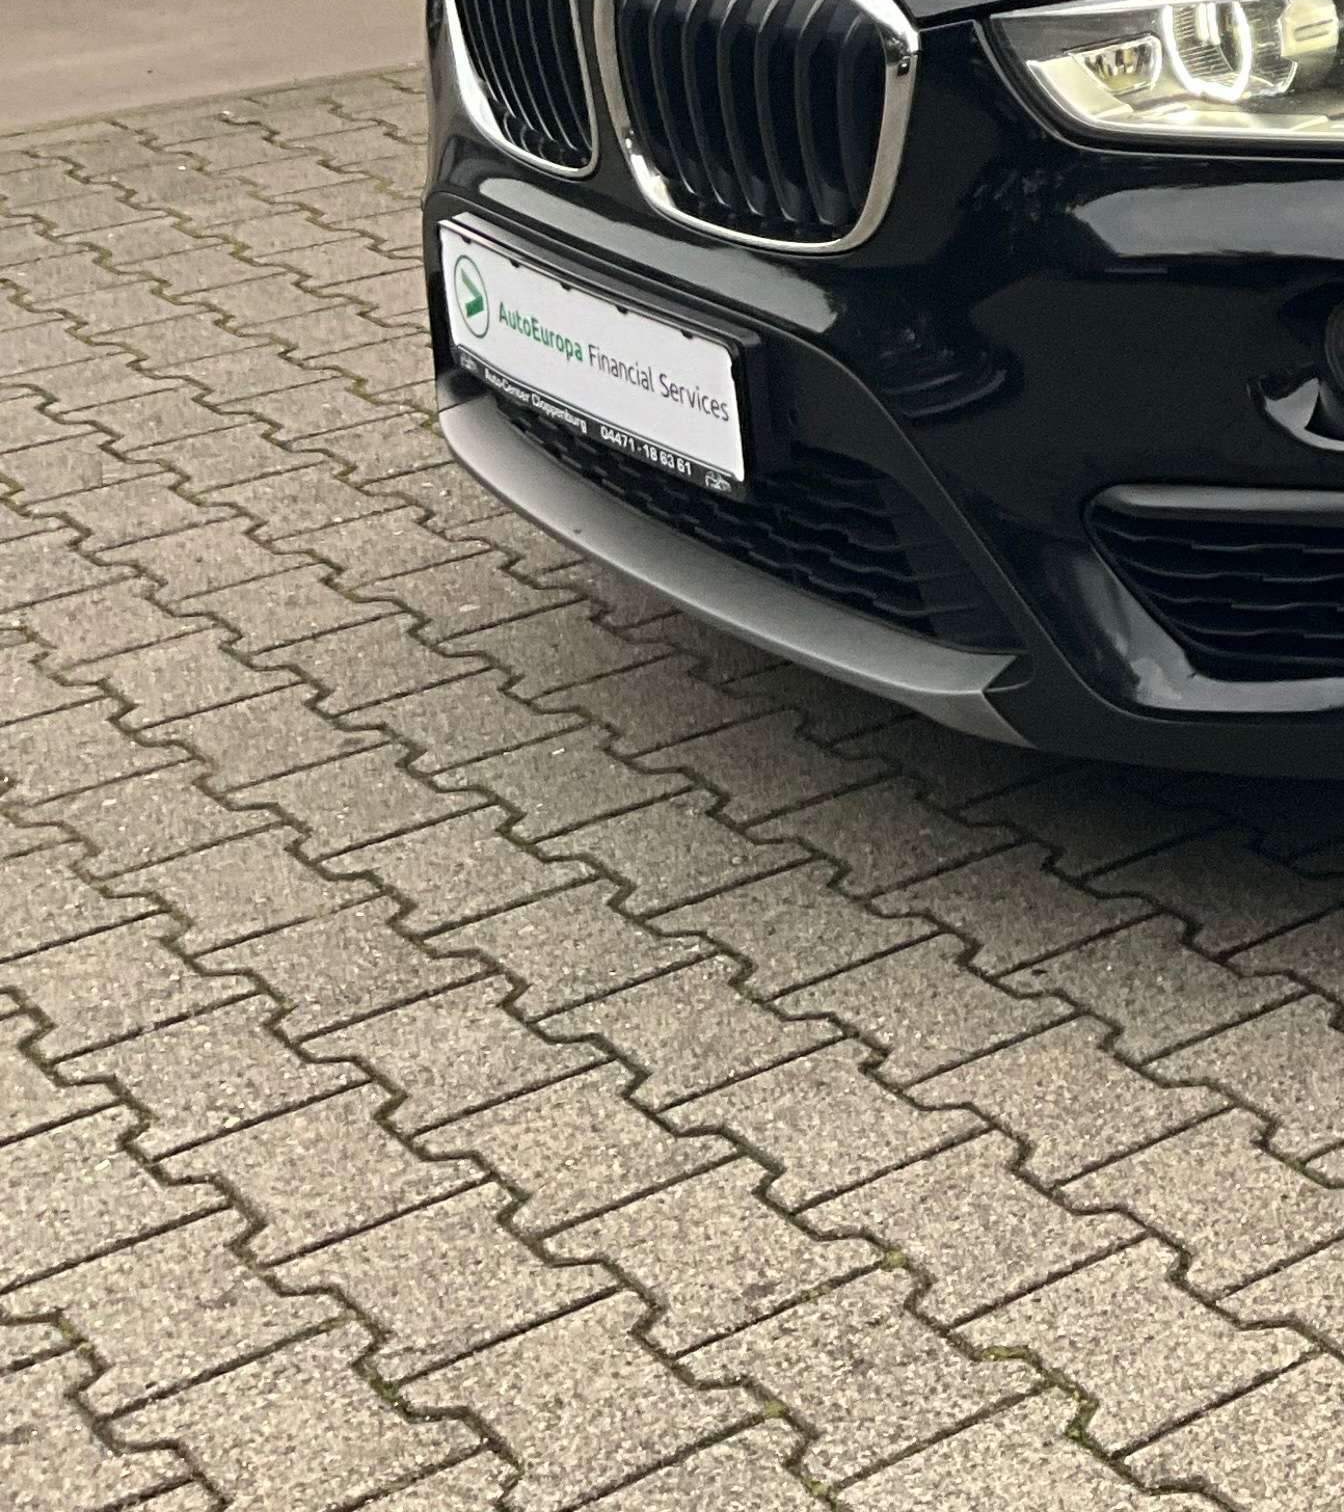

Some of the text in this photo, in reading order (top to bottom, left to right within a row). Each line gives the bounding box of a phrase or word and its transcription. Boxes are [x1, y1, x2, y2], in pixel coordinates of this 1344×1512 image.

[498, 301, 730, 422] AutoEuropa Financial Services
